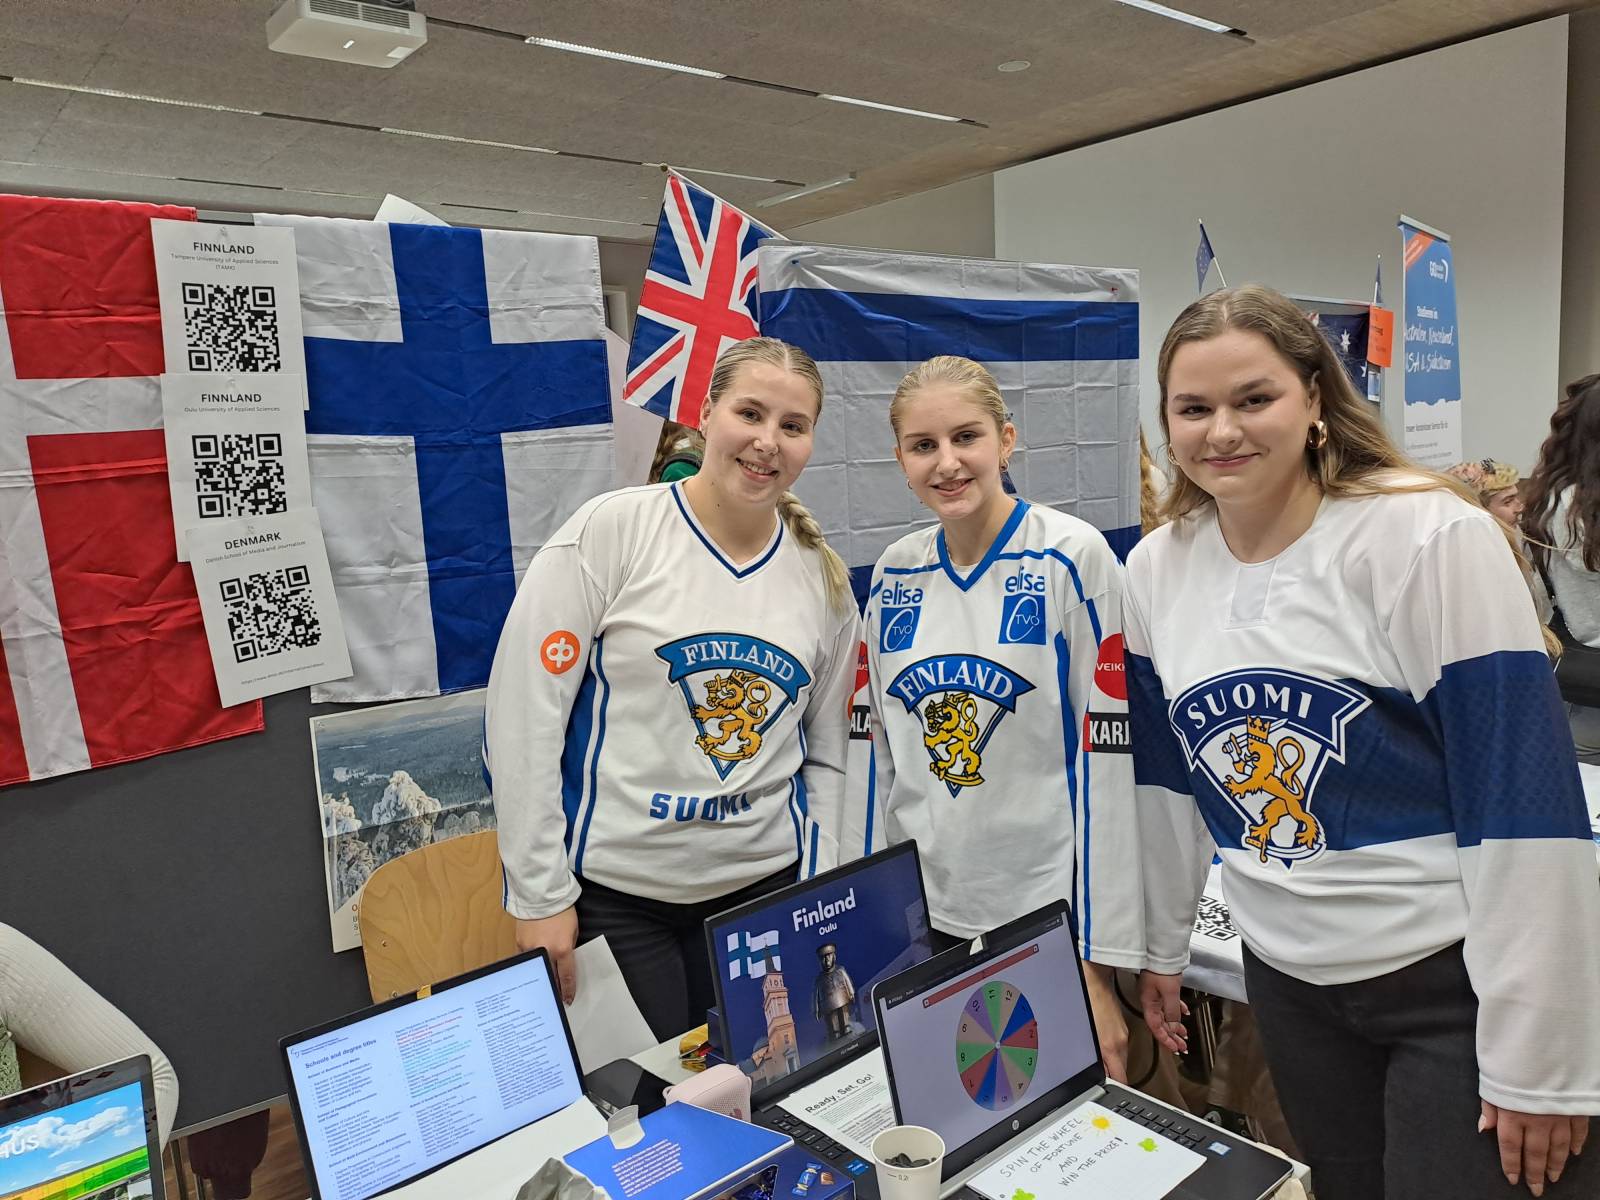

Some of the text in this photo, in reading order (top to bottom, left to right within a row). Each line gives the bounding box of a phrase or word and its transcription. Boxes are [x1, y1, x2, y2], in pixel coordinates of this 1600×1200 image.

[193, 242, 255, 254] FINNLAND
[201, 394, 262, 402] FINNLAND
[224, 532, 282, 550] DENMARK
[1005, 565, 1045, 592] elisa
[881, 581, 924, 605] elisa
[1016, 614, 1040, 626] TVO
[892, 624, 913, 636] TVO
[680, 639, 796, 683] FINLAND
[896, 659, 1014, 702] FINLAND
[1187, 682, 1313, 730] SUOMI
[1089, 720, 1132, 746] KARJ
[650, 791, 754, 822] SUOMI
[792, 887, 856, 932] Finland
[818, 922, 838, 936] Oulu
[989, 988, 995, 1000] 11
[1005, 990, 1012, 1001] 12
[305, 1056, 330, 1068] Schools
[330, 1051, 342, 1060] and
[1027, 1057, 1033, 1066] 3
[856, 1073, 874, 1085] Go!
[1000, 1118, 1083, 1178] SPIN THE WHEEL
[1030, 1132, 1083, 1174] OF FORTUNE
[1058, 1136, 1128, 1186] WIN THE PRIZE!
[1058, 1155, 1078, 1172] AND
